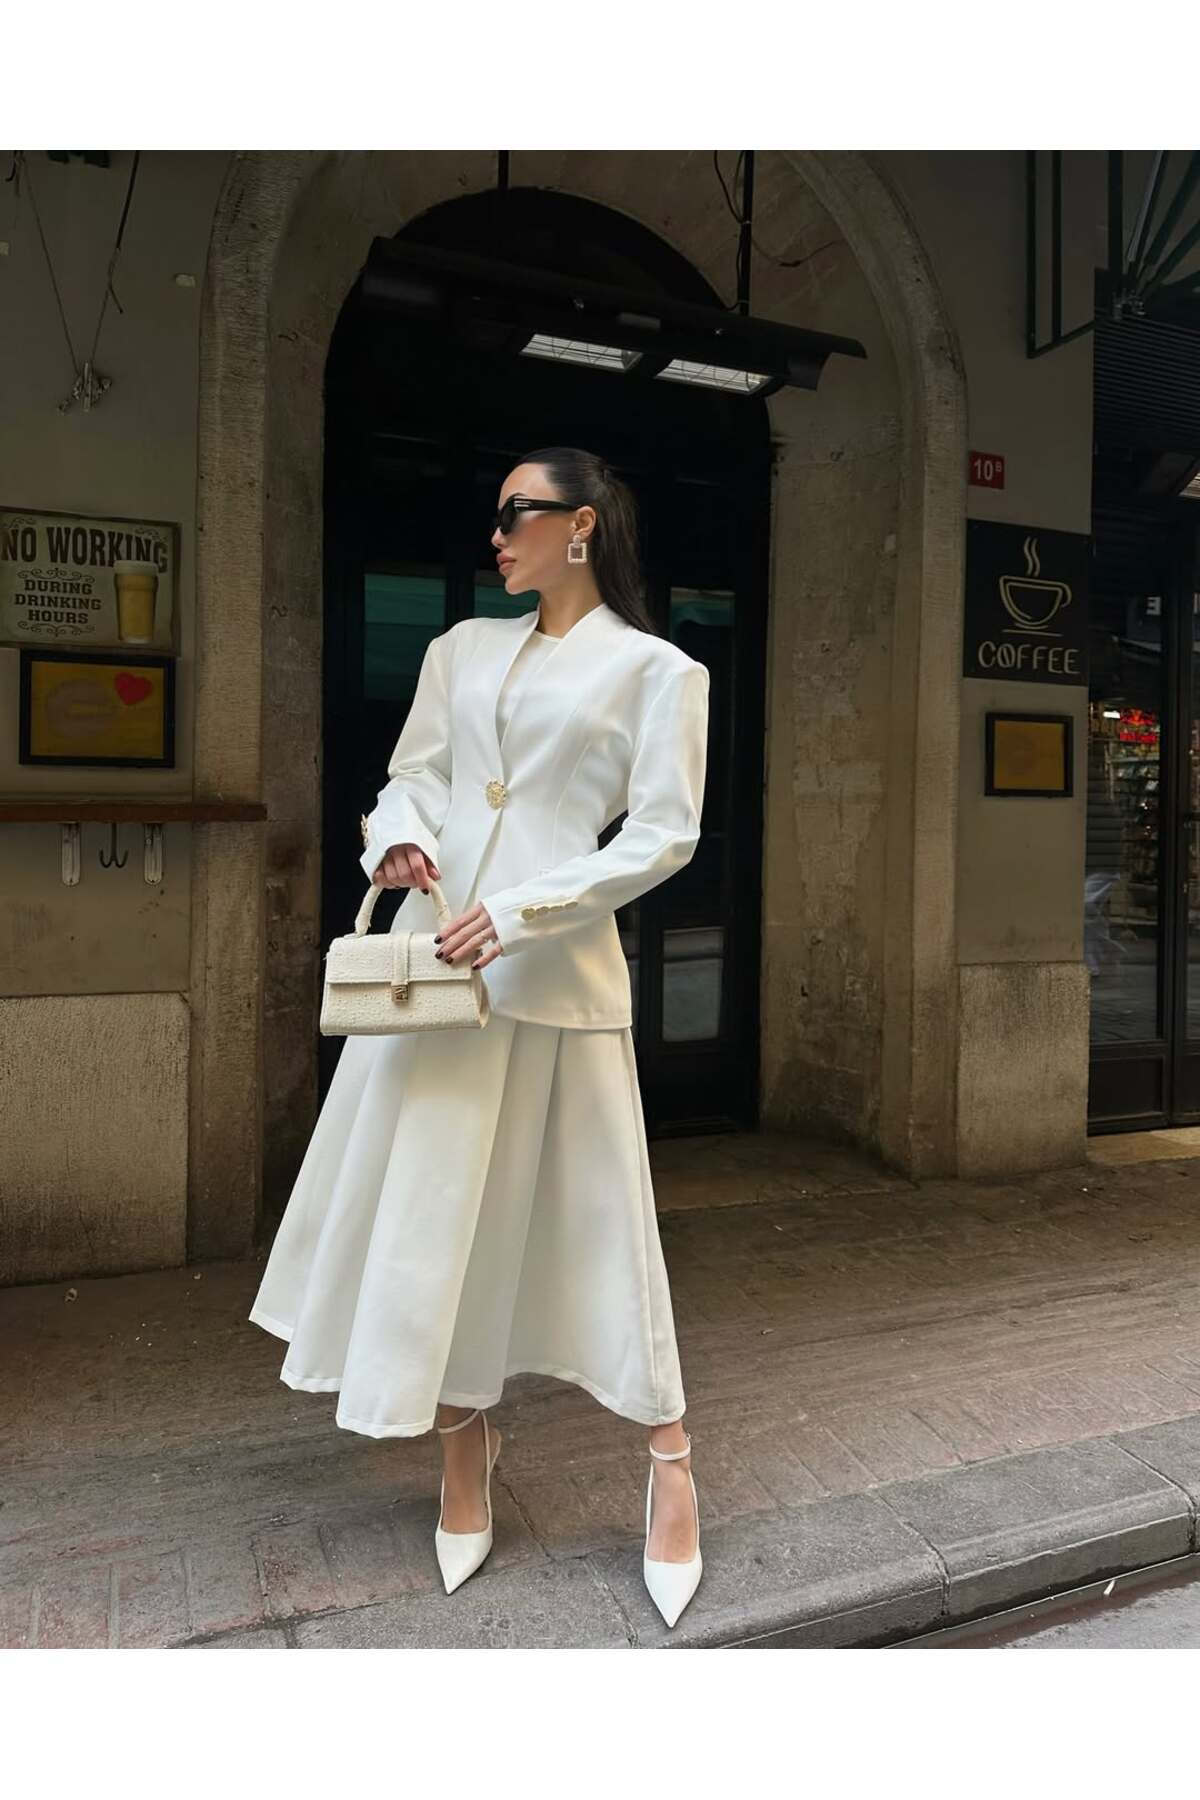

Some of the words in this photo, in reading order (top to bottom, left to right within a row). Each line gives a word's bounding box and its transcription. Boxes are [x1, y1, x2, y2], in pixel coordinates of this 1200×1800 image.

[0, 526, 37, 563] NO
[46, 526, 169, 574] WORKING
[24, 579, 93, 596] DURING
[14, 594, 103, 611] DRINKING
[27, 609, 89, 625] HOURS
[977, 640, 1081, 675] COFFEE
